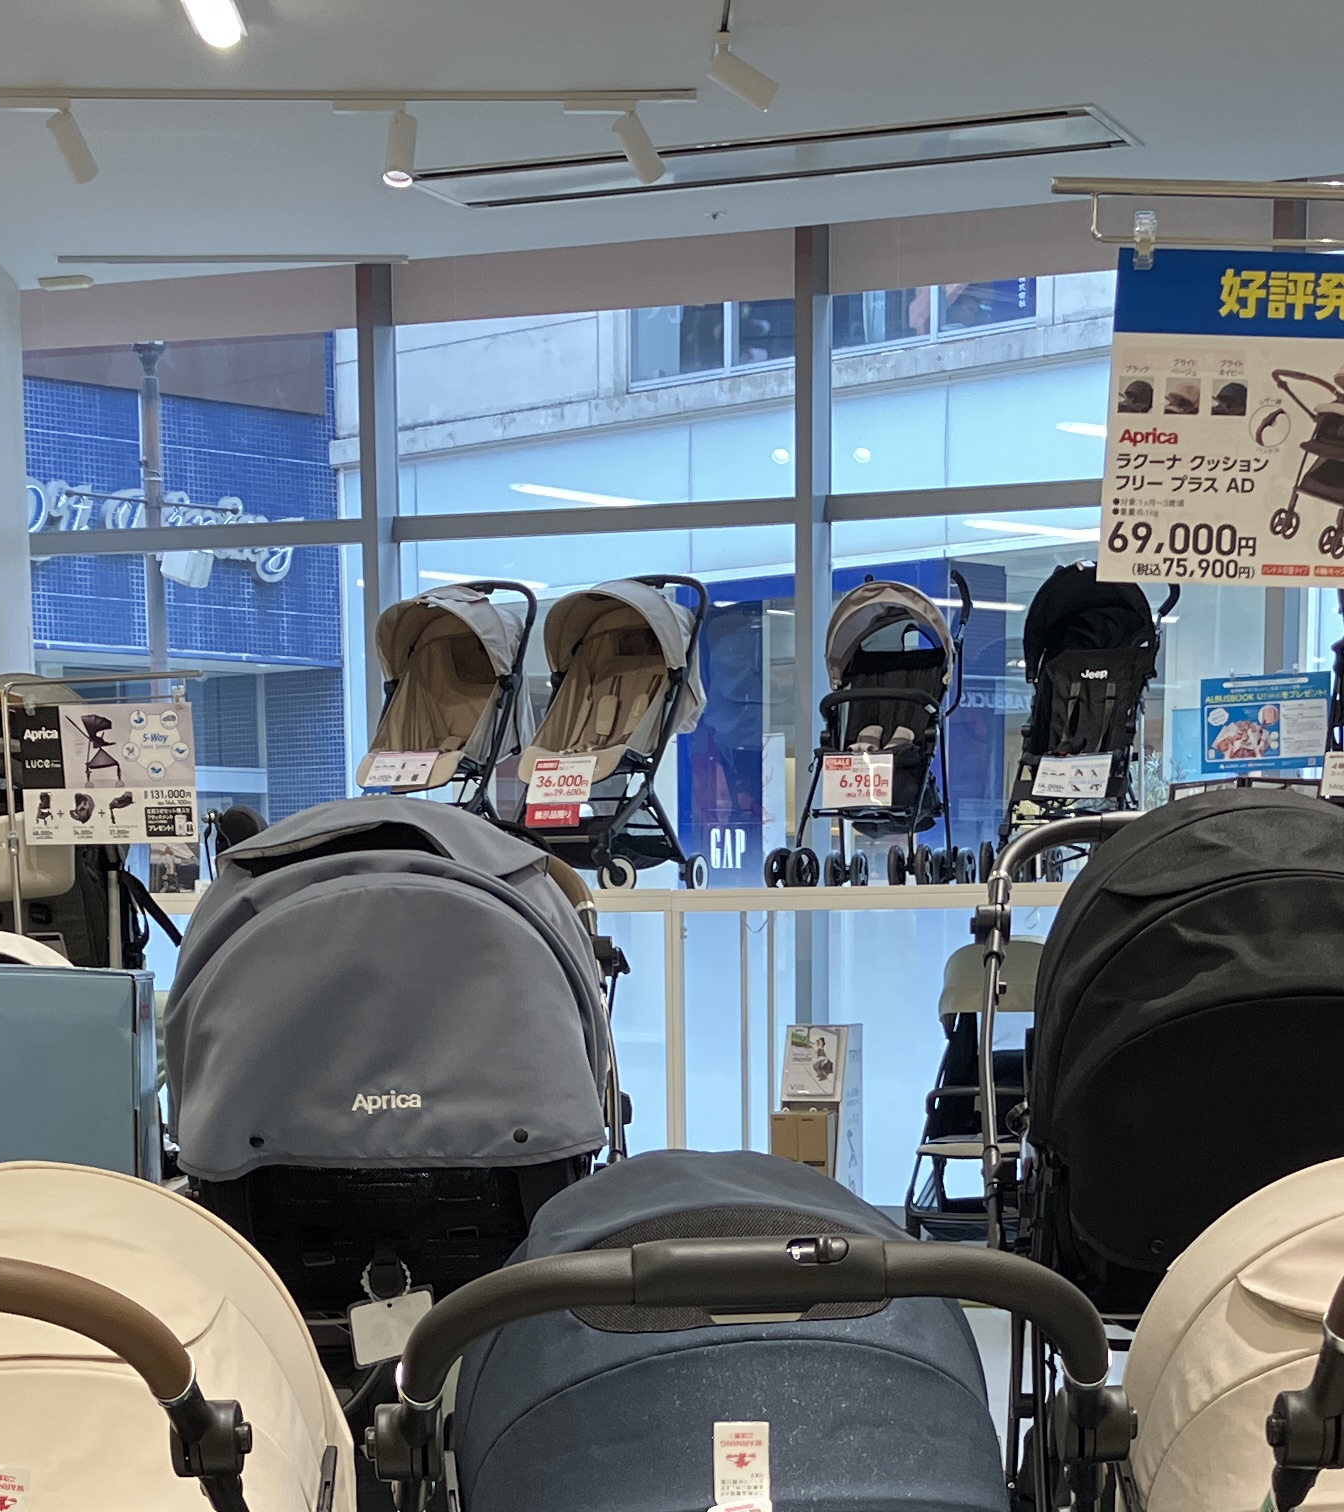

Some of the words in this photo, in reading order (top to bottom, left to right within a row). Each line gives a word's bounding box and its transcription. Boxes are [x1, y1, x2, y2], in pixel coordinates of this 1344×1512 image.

[1119, 427, 1178, 446] Aprica
[1116, 453, 1182, 470] ラクーナ
[1190, 455, 1269, 472] クッション
[1116, 475, 1163, 491] フリー
[1171, 475, 1218, 492] プラス
[1226, 478, 1255, 493] AD
[1108, 521, 1257, 556] 69,000円
[1081, 669, 1108, 679] Jeep
[23, 727, 58, 740] Aprica
[536, 775, 589, 788] 36,000円
[351, 1090, 422, 1114] Aprica
[720, 1439, 763, 1448] WARNING
